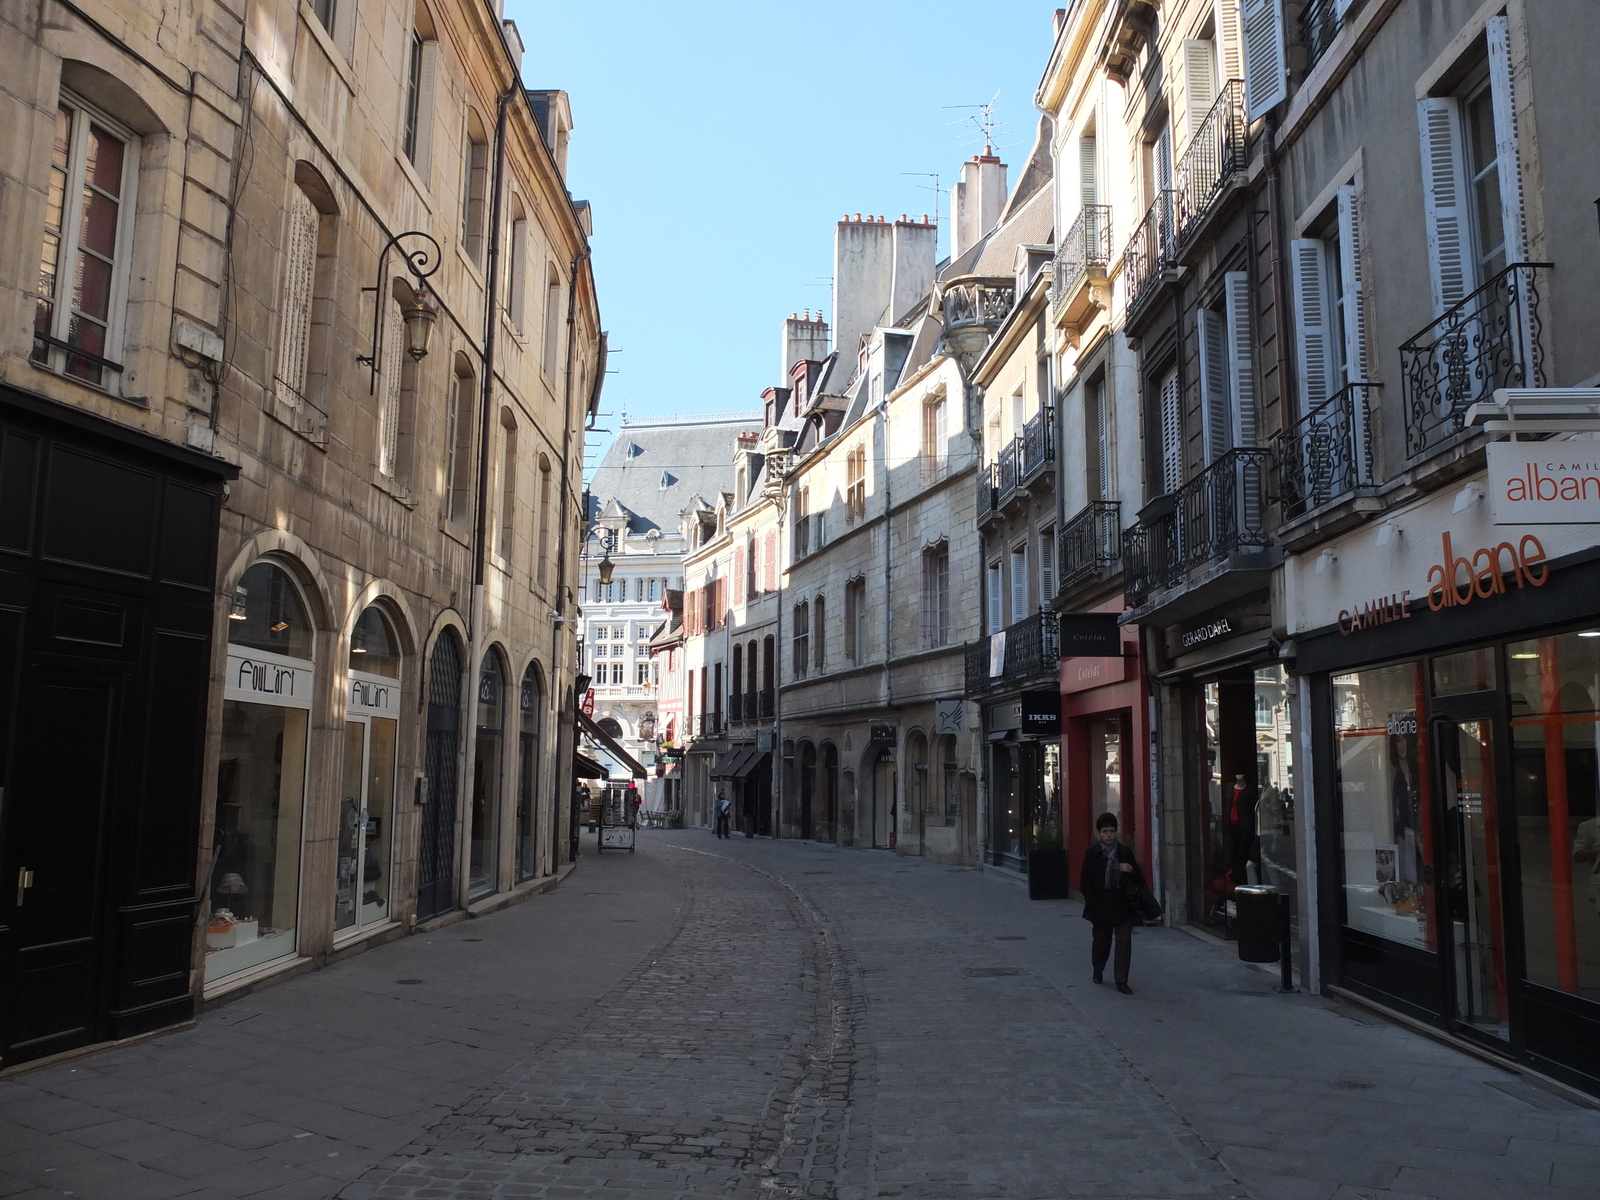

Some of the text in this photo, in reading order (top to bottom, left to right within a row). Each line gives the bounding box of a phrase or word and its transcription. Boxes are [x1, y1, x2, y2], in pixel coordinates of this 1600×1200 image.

[1506, 462, 1600, 502] alban
[1337, 530, 1550, 636] CAMILLE albane
[1181, 618, 1232, 647] GERARD DAREL
[1387, 713, 1417, 735] albane
